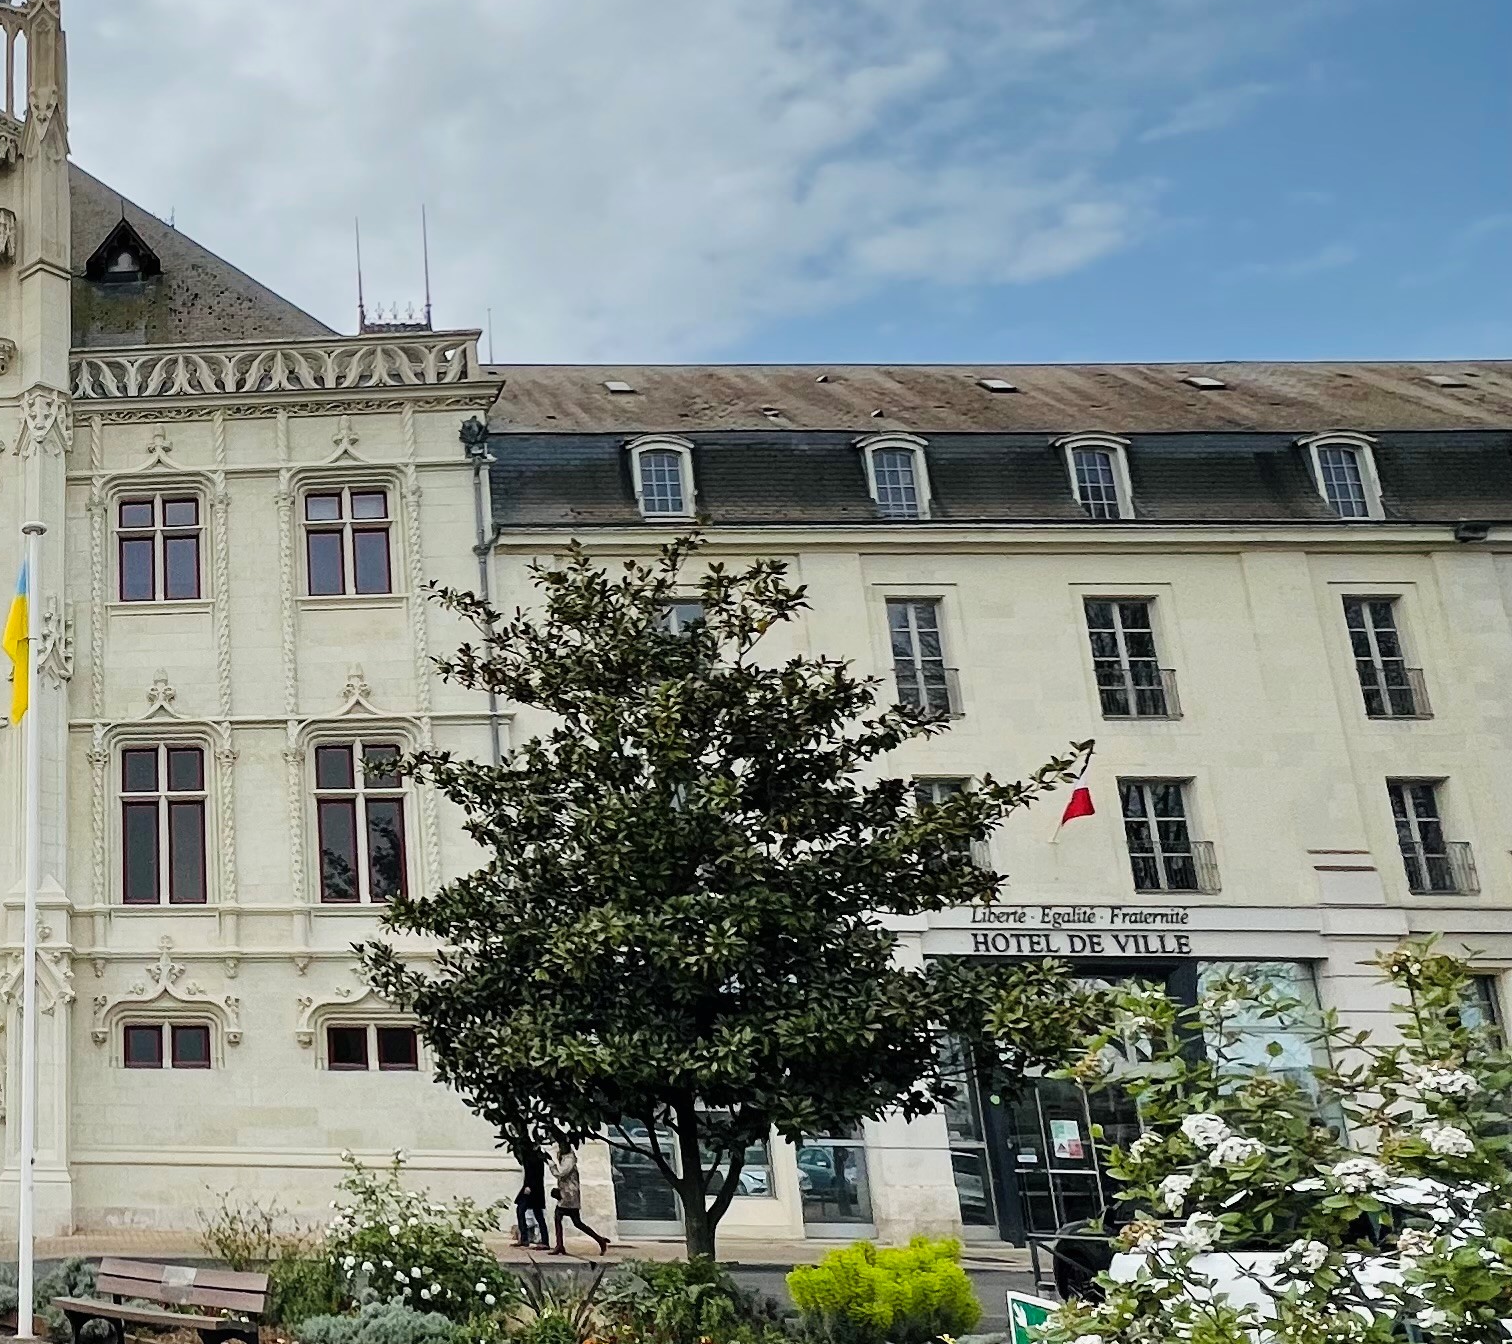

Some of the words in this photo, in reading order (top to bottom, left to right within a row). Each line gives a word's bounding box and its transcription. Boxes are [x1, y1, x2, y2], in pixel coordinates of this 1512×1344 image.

[1110, 906, 1189, 924] Fraternité
[971, 932, 1061, 953] HOTEL
[1067, 933, 1105, 954] DE
[1111, 934, 1192, 954] VILLE
